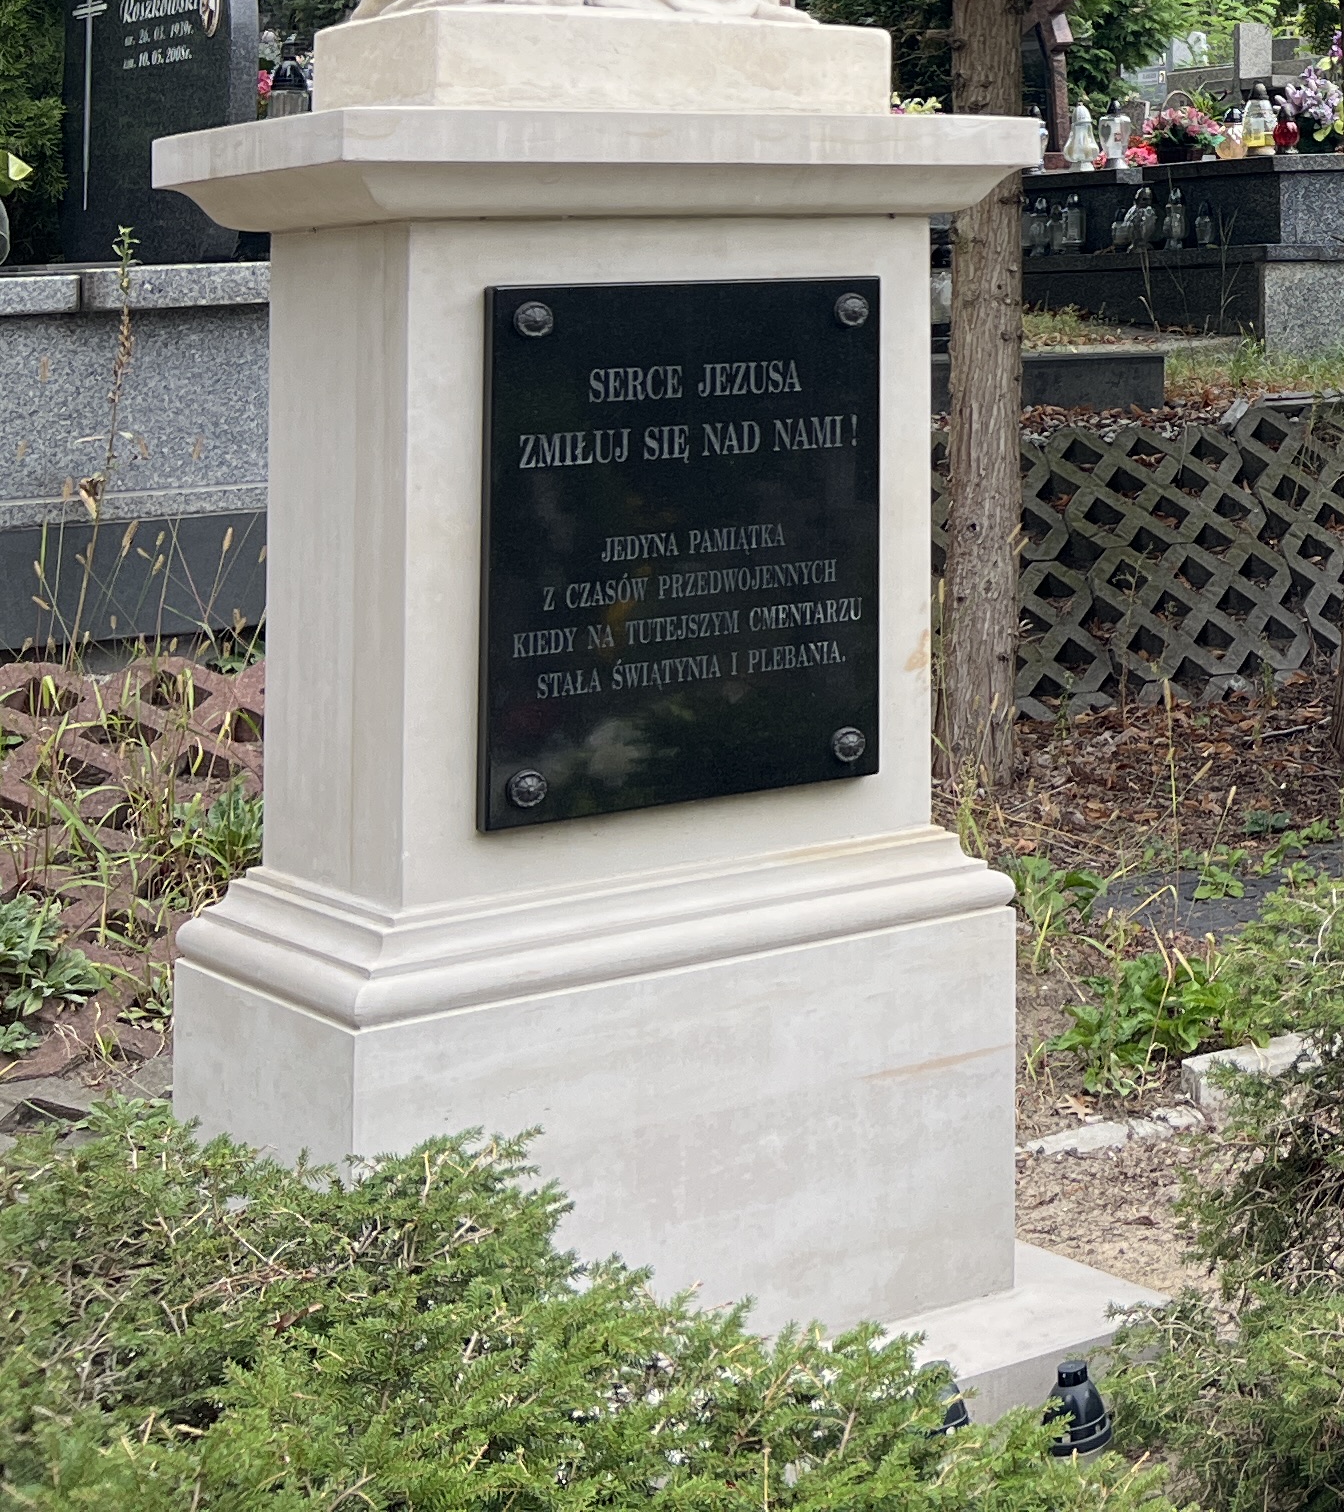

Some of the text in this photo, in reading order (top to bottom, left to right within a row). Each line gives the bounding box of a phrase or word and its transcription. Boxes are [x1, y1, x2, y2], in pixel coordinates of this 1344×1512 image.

[588, 359, 803, 403] SERCE JEZUSA
[519, 428, 632, 469] ZMIŁUJ
[643, 424, 690, 464] SIĘ
[702, 420, 761, 456] NAD
[601, 523, 787, 563] JEDYNA PAMIĄTKA
[543, 558, 837, 612] Z CZASÓW PRZEDWOJENNYCH
[512, 597, 863, 659] KIEDY NA TUTEJSZYM CMENTARZU
[536, 639, 847, 700] STAŁA ŚWIĄTYNIA I PLEBANIA.
